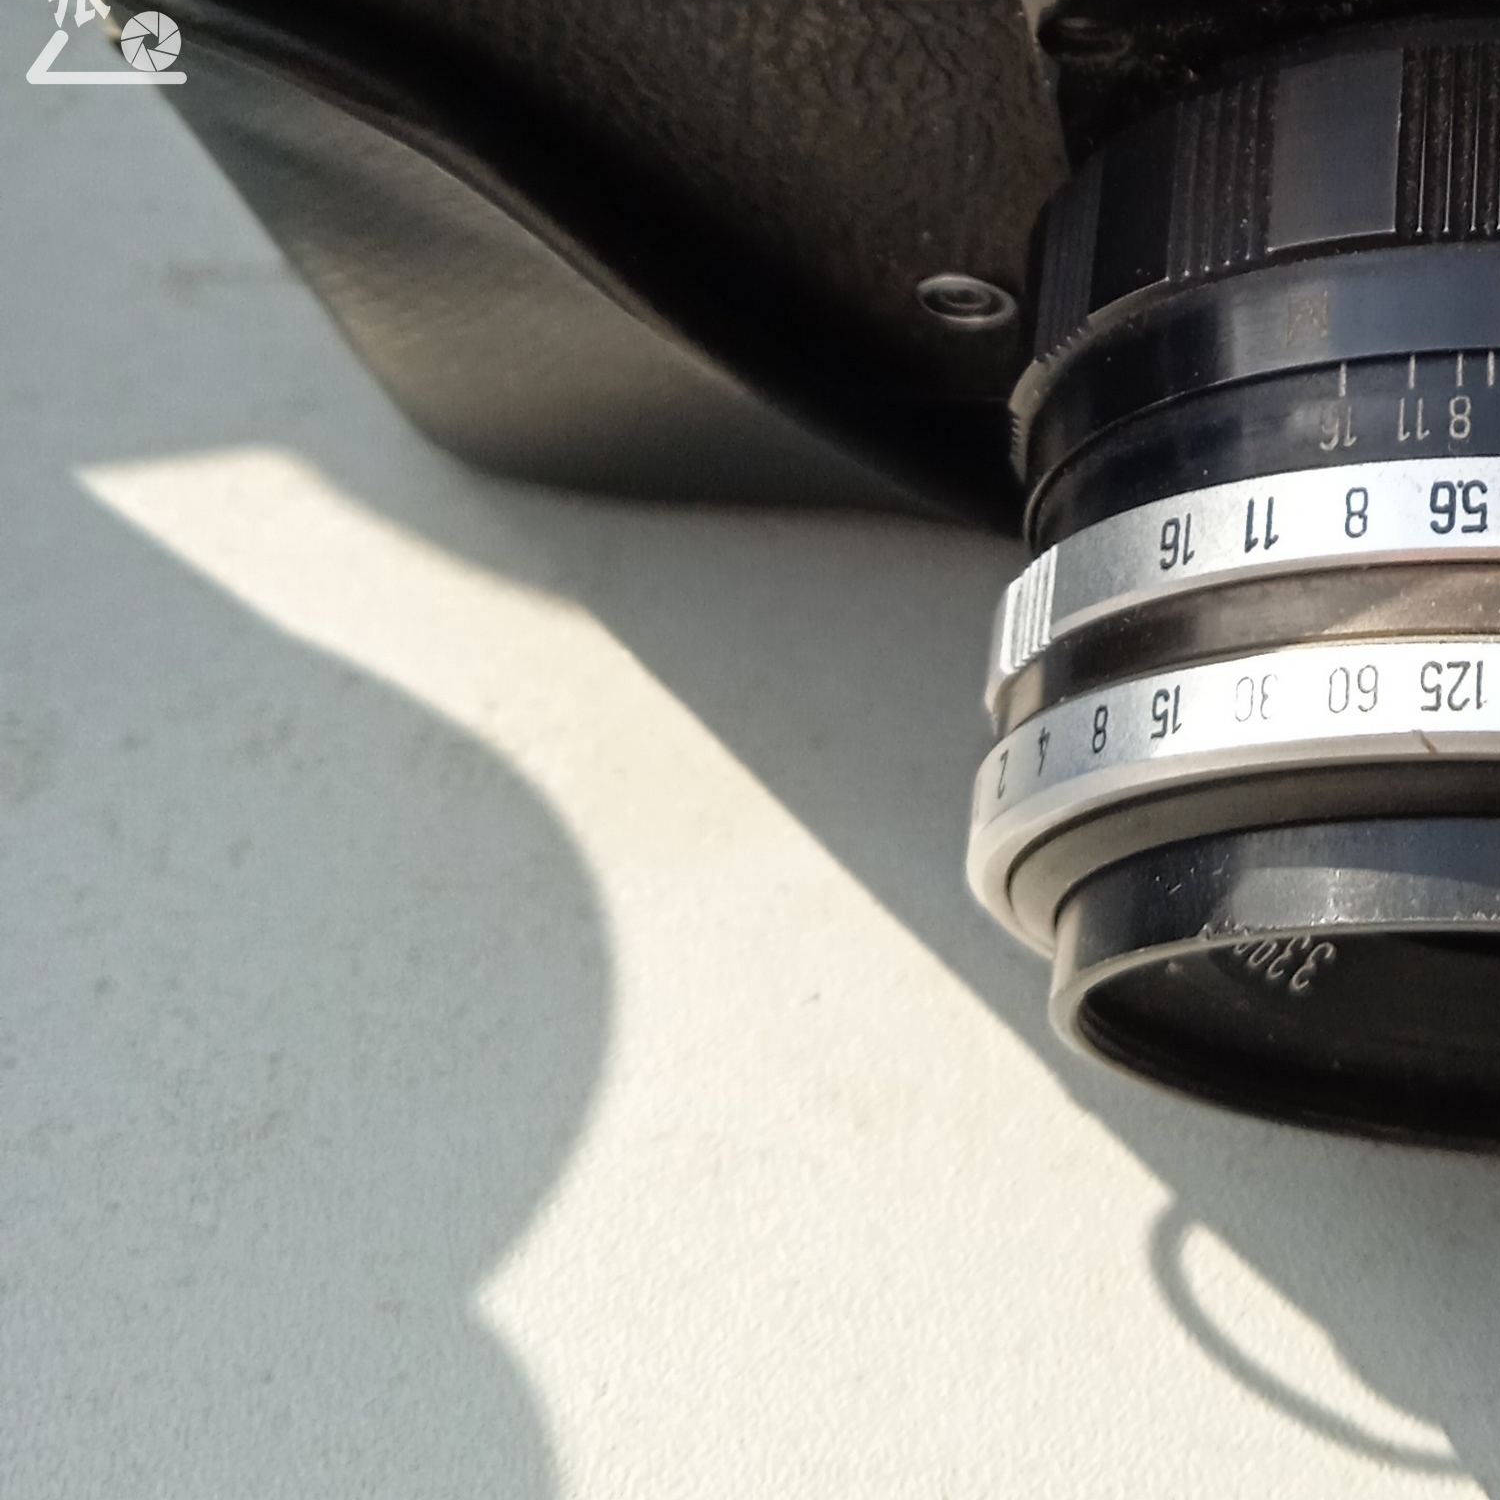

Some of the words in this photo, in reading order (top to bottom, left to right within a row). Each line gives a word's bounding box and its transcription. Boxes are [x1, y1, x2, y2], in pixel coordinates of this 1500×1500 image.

[1318, 405, 1358, 452] 16
[1396, 396, 1432, 442] 11
[1448, 395, 1473, 440] 8
[1243, 496, 1280, 553] 11
[1343, 485, 1370, 539] 8
[1428, 478, 1489, 535] 5.6
[1159, 511, 1196, 571] 16
[1150, 684, 1183, 740] 15
[1233, 673, 1280, 723] 30
[1327, 663, 1381, 714] 60
[1419, 659, 1489, 713] 125
[1037, 726, 1051, 778] 4
[1091, 704, 1109, 754] 8
